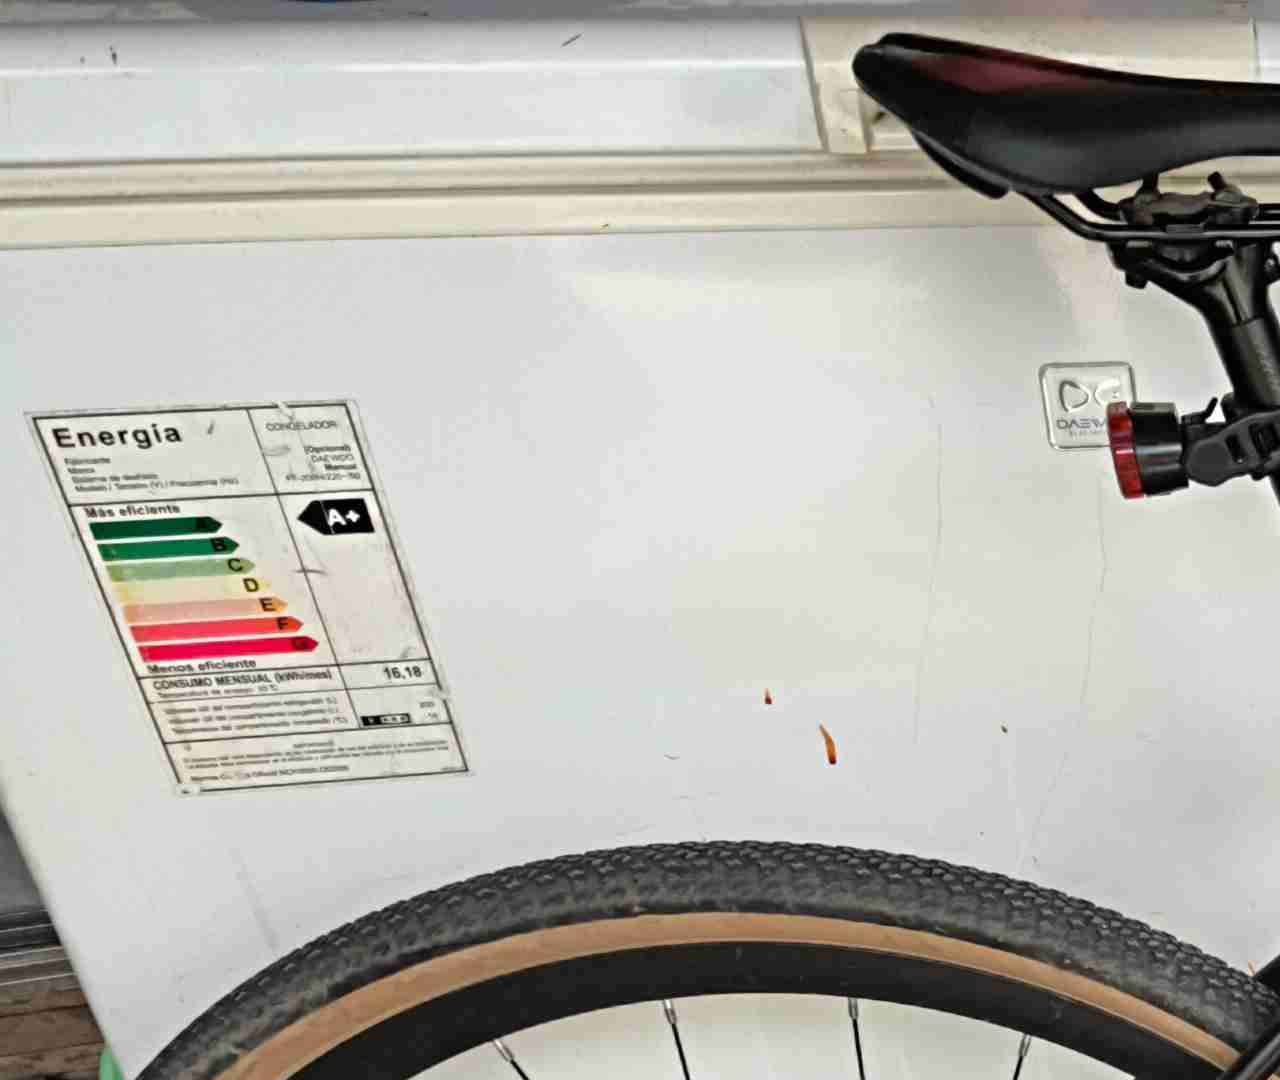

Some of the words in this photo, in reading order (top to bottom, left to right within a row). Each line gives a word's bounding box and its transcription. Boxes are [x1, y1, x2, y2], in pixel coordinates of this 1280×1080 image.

[328, 508, 361, 528] A+
[210, 537, 227, 553] B
[227, 558, 245, 573] C
[242, 577, 260, 593] D
[258, 597, 277, 612] E
[276, 616, 290, 631] F
[198, 659, 257, 672] eficiente
[153, 678, 213, 690] CONSUMO
[215, 673, 273, 686] MENSUAL
